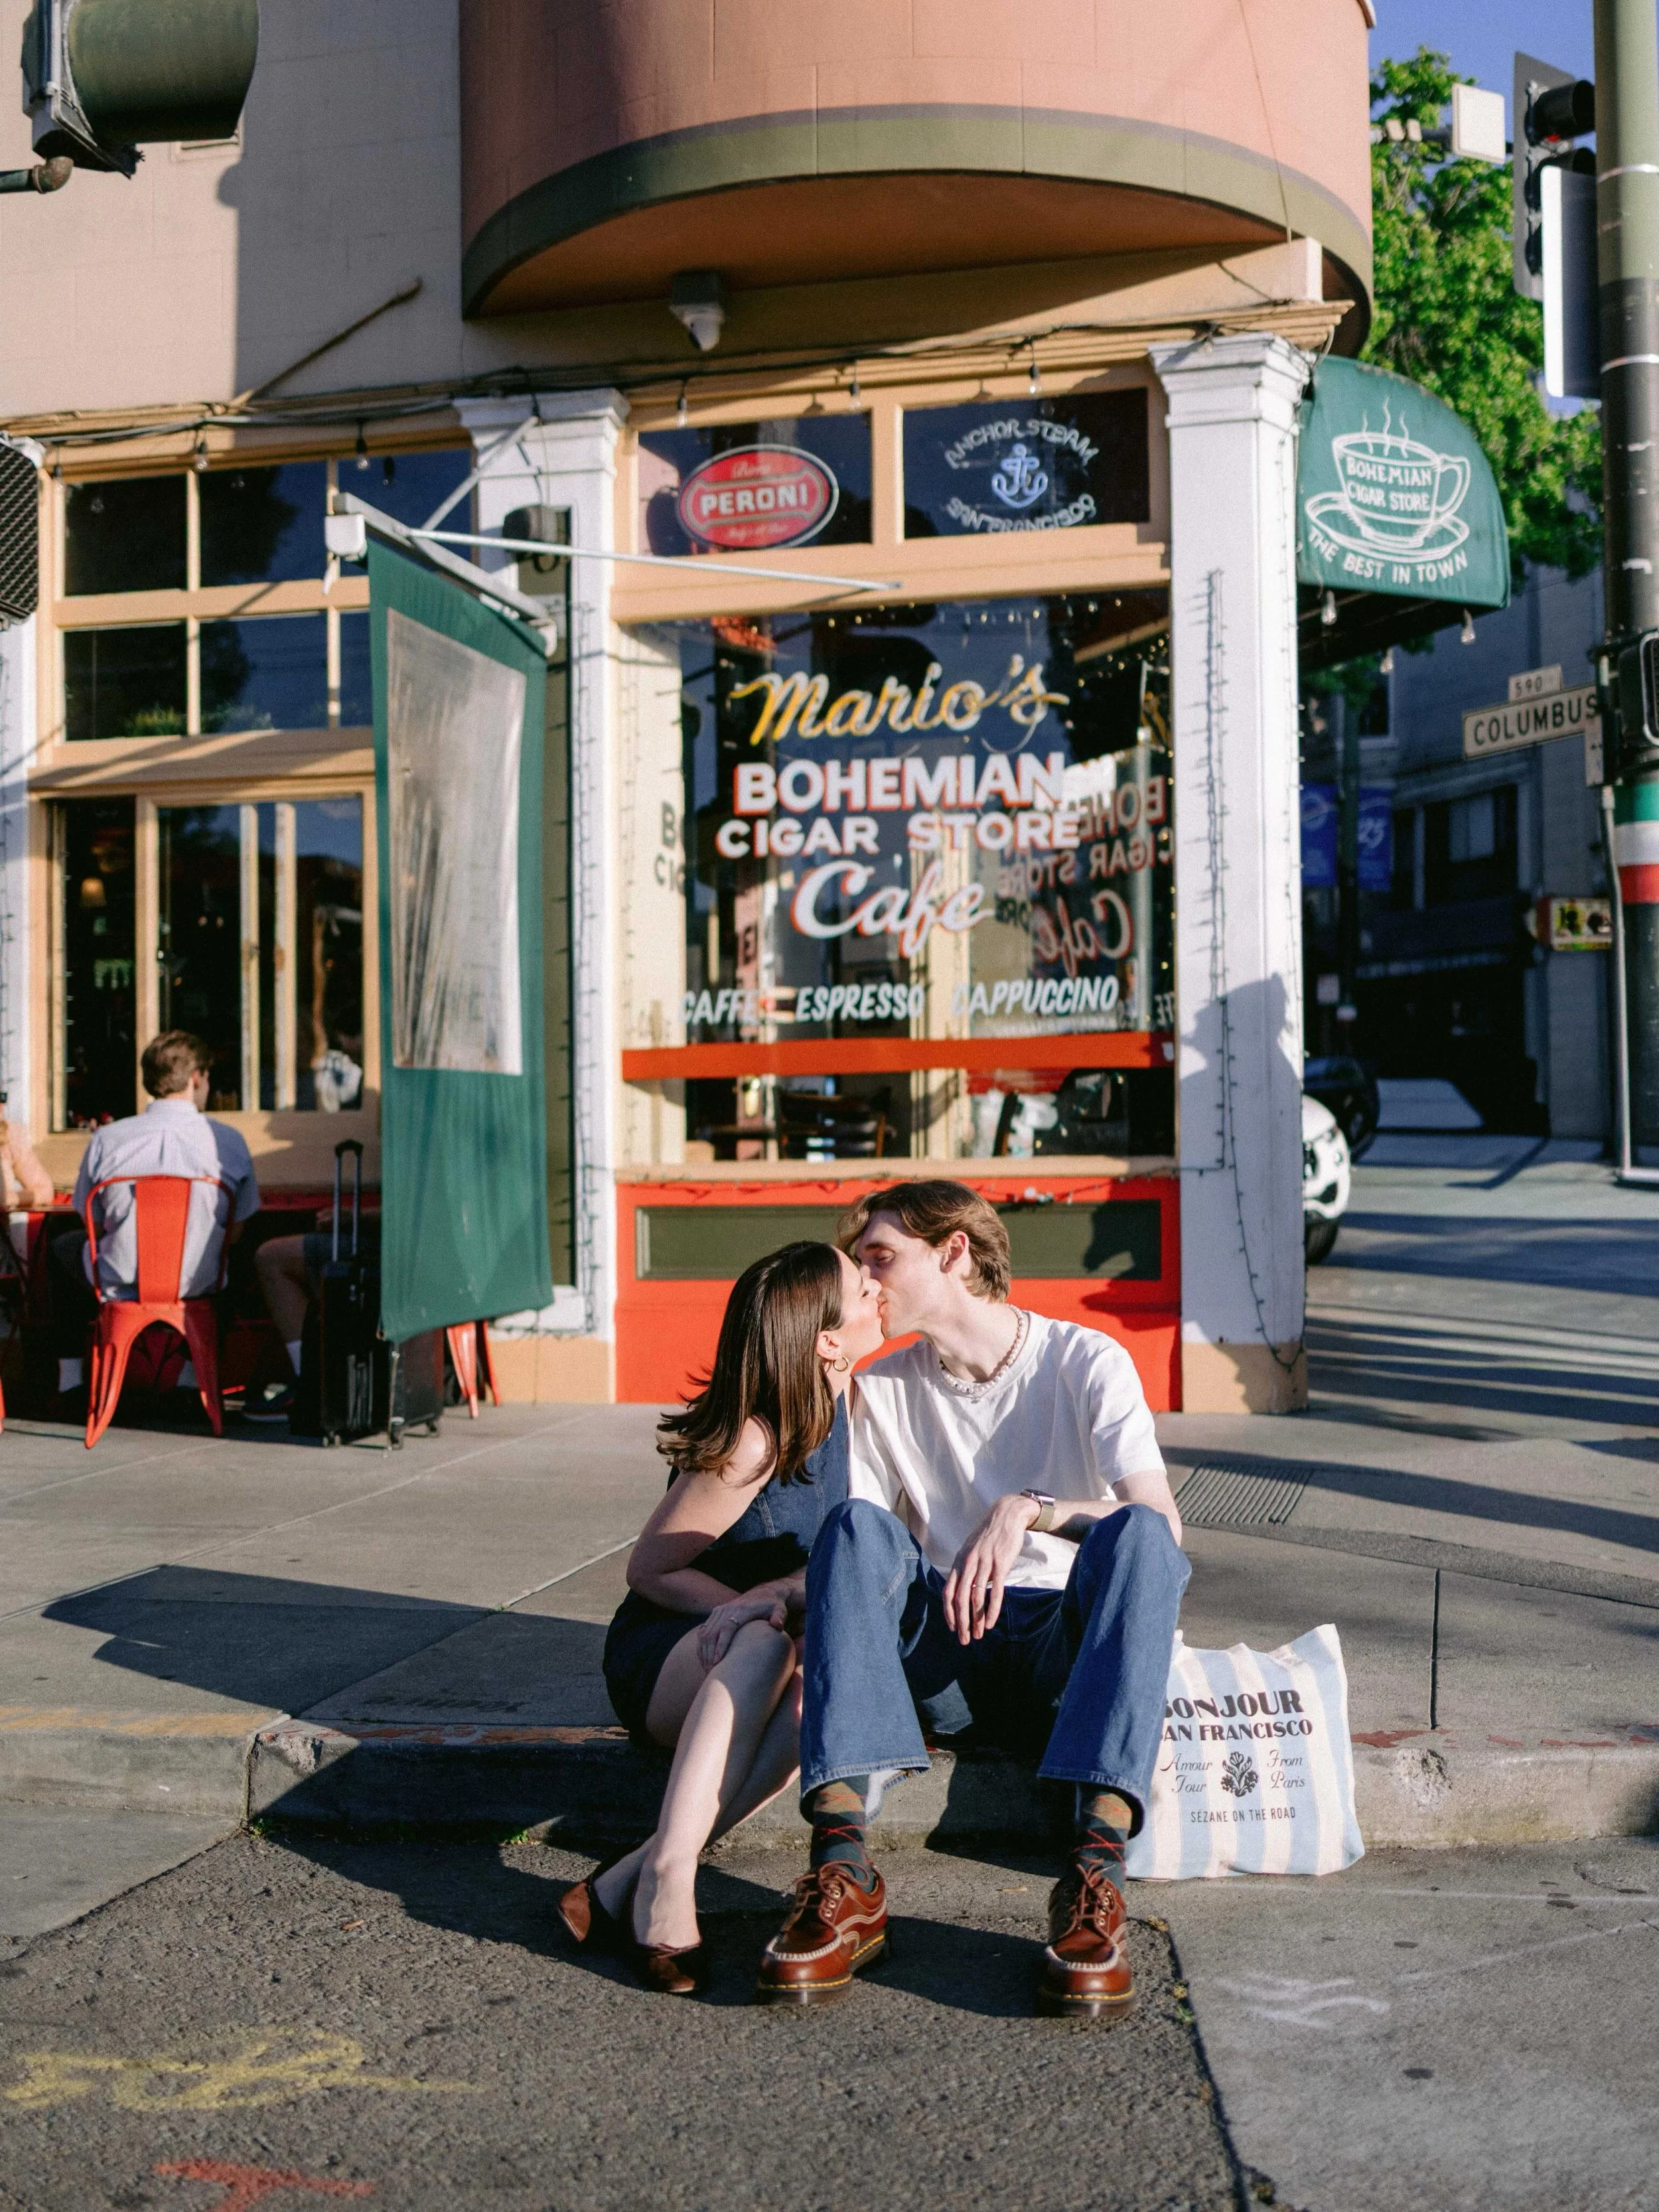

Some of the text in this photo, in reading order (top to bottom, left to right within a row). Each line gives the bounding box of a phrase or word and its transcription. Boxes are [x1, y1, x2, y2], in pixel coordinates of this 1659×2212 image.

[945, 419, 1099, 469] ANCHOR STEAM
[1346, 456, 1432, 486] BOHEMIAN
[700, 483, 808, 516] PERONI
[1347, 480, 1429, 511] CIGAR STORE
[1308, 525, 1469, 585] THE BEST IN TOWN
[730, 654, 1070, 746] Mario's
[1474, 693, 1598, 746] COLUMBUS
[733, 751, 1066, 816] BOHEMIAN
[715, 816, 880, 859] CIGAR
[906, 811, 1081, 851] STORE
[789, 859, 995, 958] Cafe
[796, 982, 926, 1023] ESPRESSO
[950, 974, 1119, 1017] CAPPUCCINO
[1163, 1719, 1313, 1741] AN FRANCISCO
[1160, 1753, 1213, 1771] Amour
[1267, 1749, 1303, 1767] From
[1271, 1770, 1305, 1790] Paris
[1232, 1810, 1245, 1822] ON
[1249, 1808, 1267, 1820] THE
[1270, 1806, 1295, 1819] ROAD
